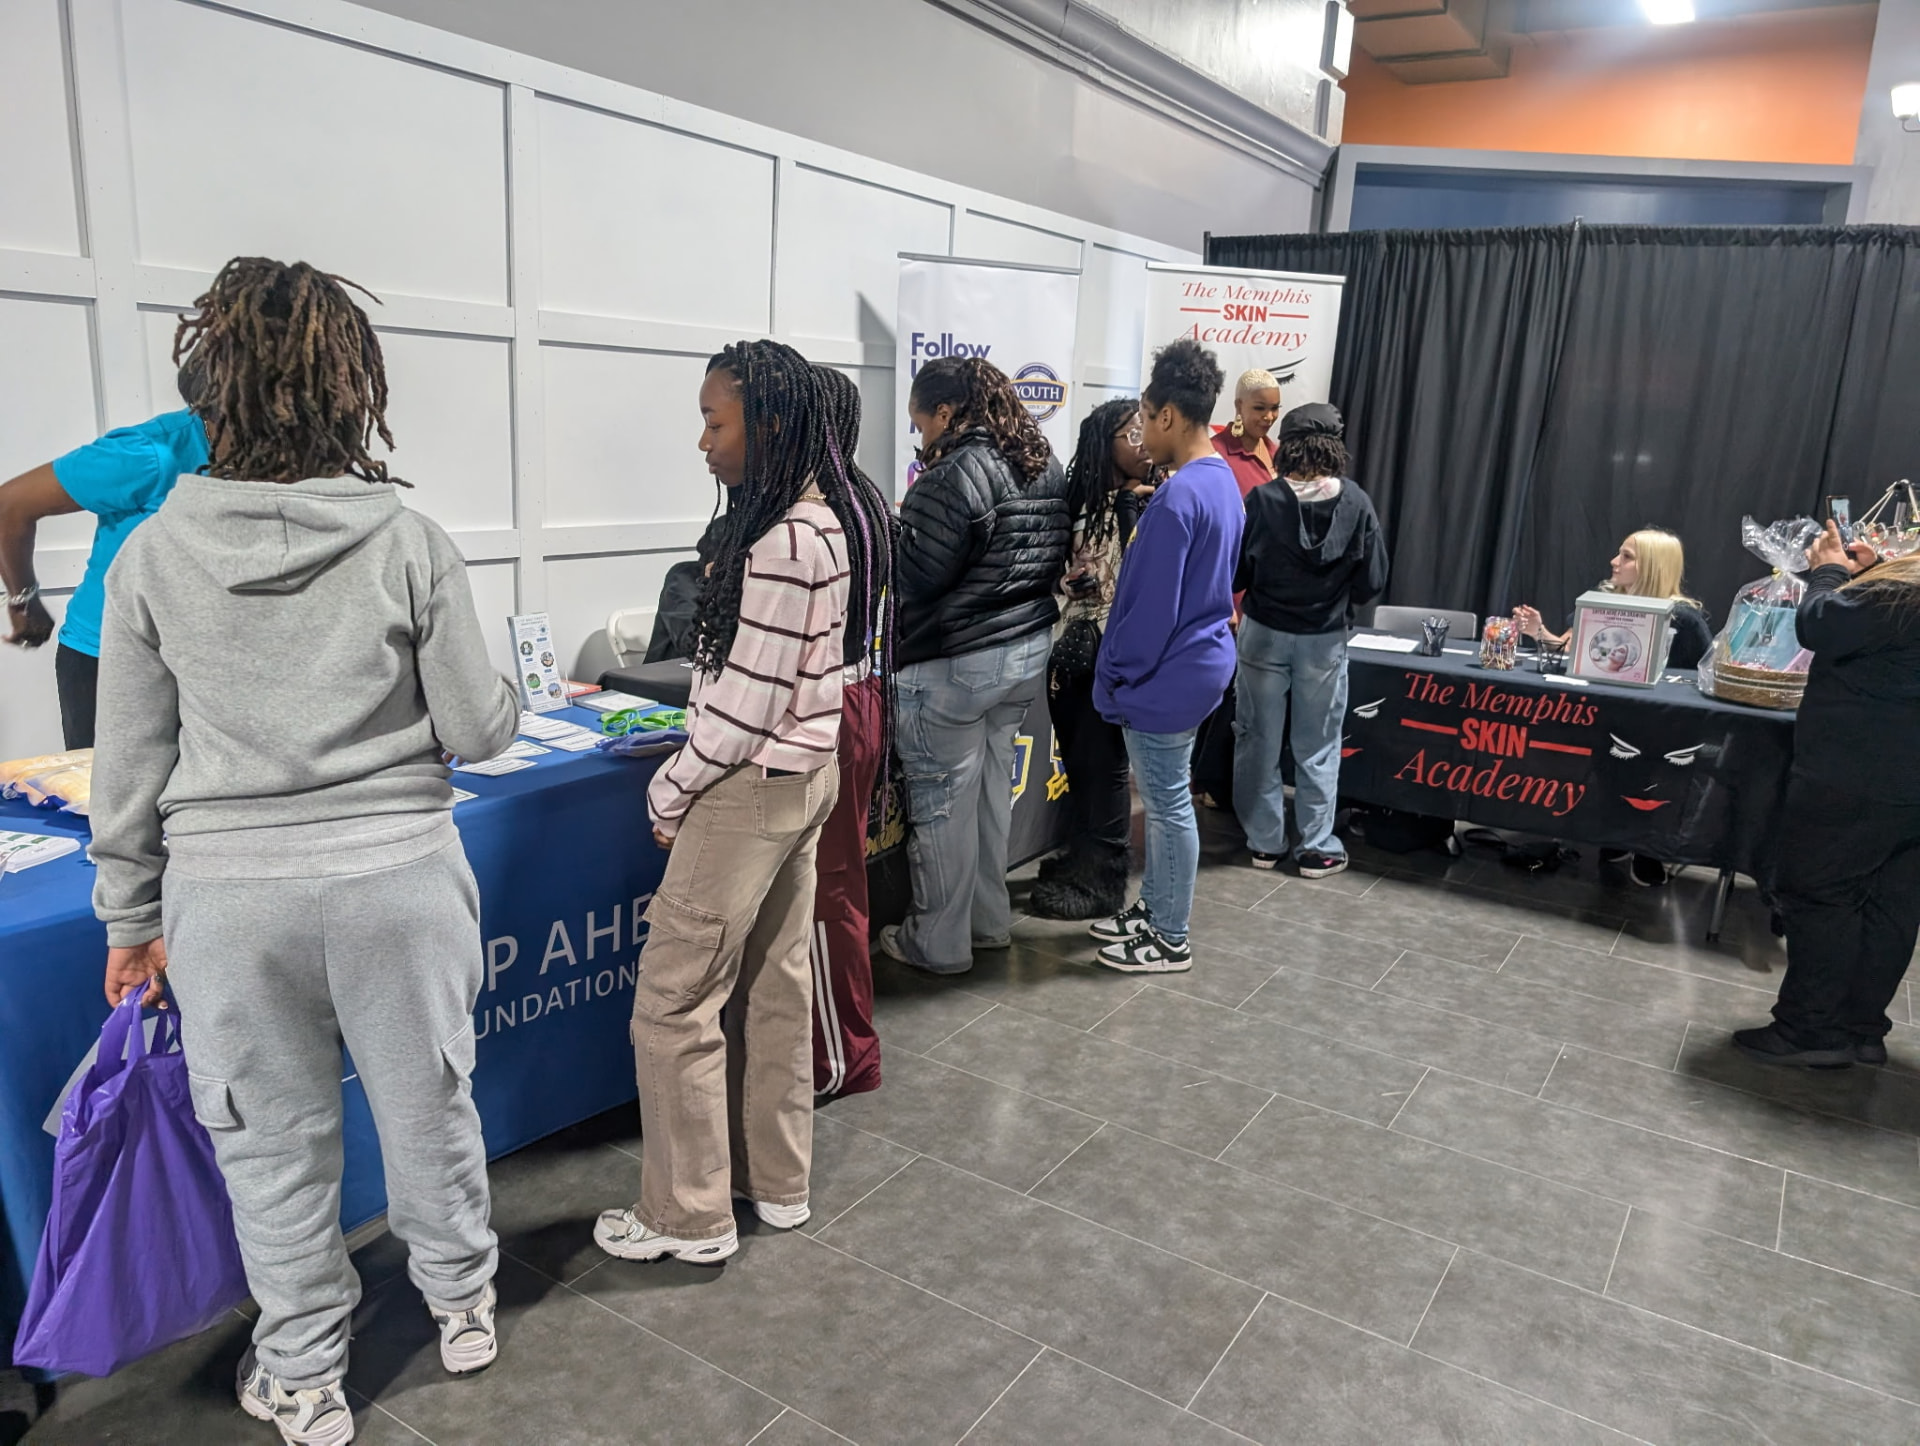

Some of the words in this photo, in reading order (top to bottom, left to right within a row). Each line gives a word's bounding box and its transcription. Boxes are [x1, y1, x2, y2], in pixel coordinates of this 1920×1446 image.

[1182, 282, 1217, 298] The
[1222, 285, 1312, 305] Memphis
[1223, 303, 1267, 322] SKIN
[911, 332, 991, 359] Follow
[1179, 322, 1307, 351] Academy
[1014, 385, 1060, 400] YOUTH
[1405, 672, 1455, 706] The
[1459, 683, 1599, 727] Memphis
[1458, 717, 1530, 759] SKIN
[1394, 748, 1587, 816] Academy
